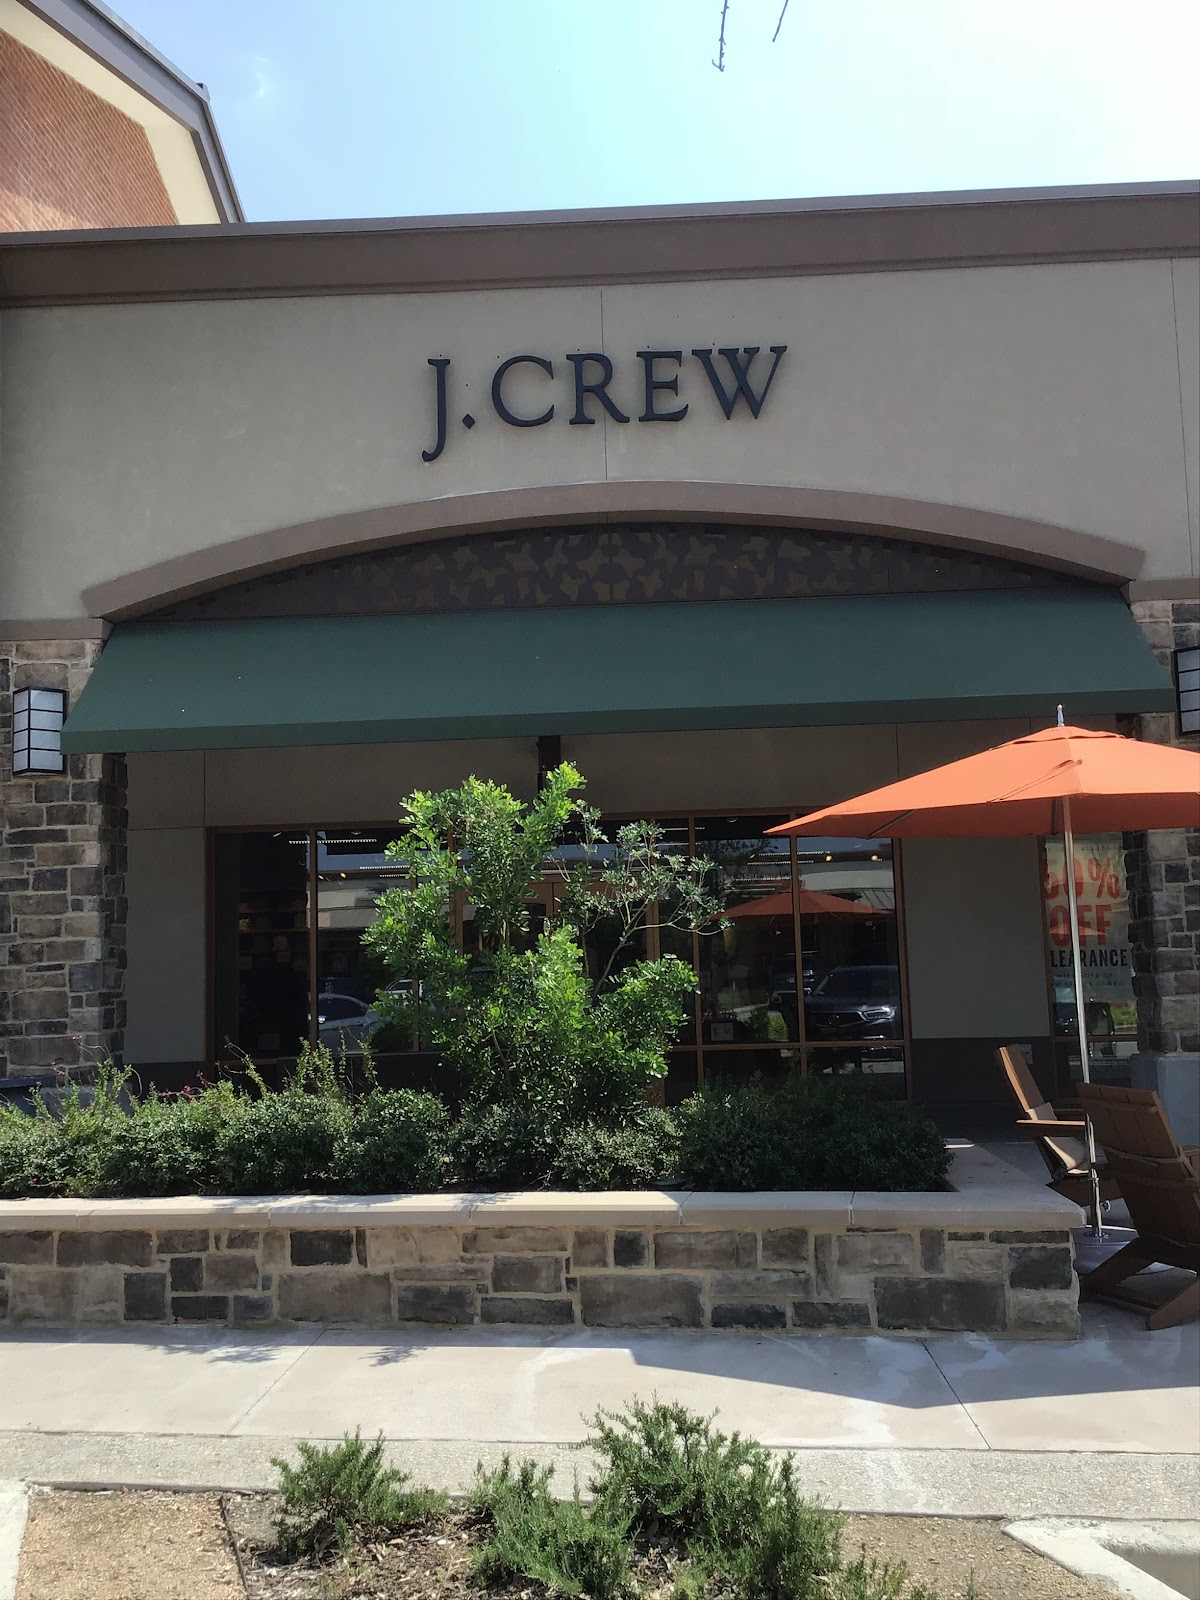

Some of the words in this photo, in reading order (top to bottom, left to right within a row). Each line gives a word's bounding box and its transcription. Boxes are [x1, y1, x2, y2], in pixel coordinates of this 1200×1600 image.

[422, 345, 788, 462] J.CREW
[1049, 904, 1112, 947] OFF
[1050, 948, 1128, 968] LEARANCE
